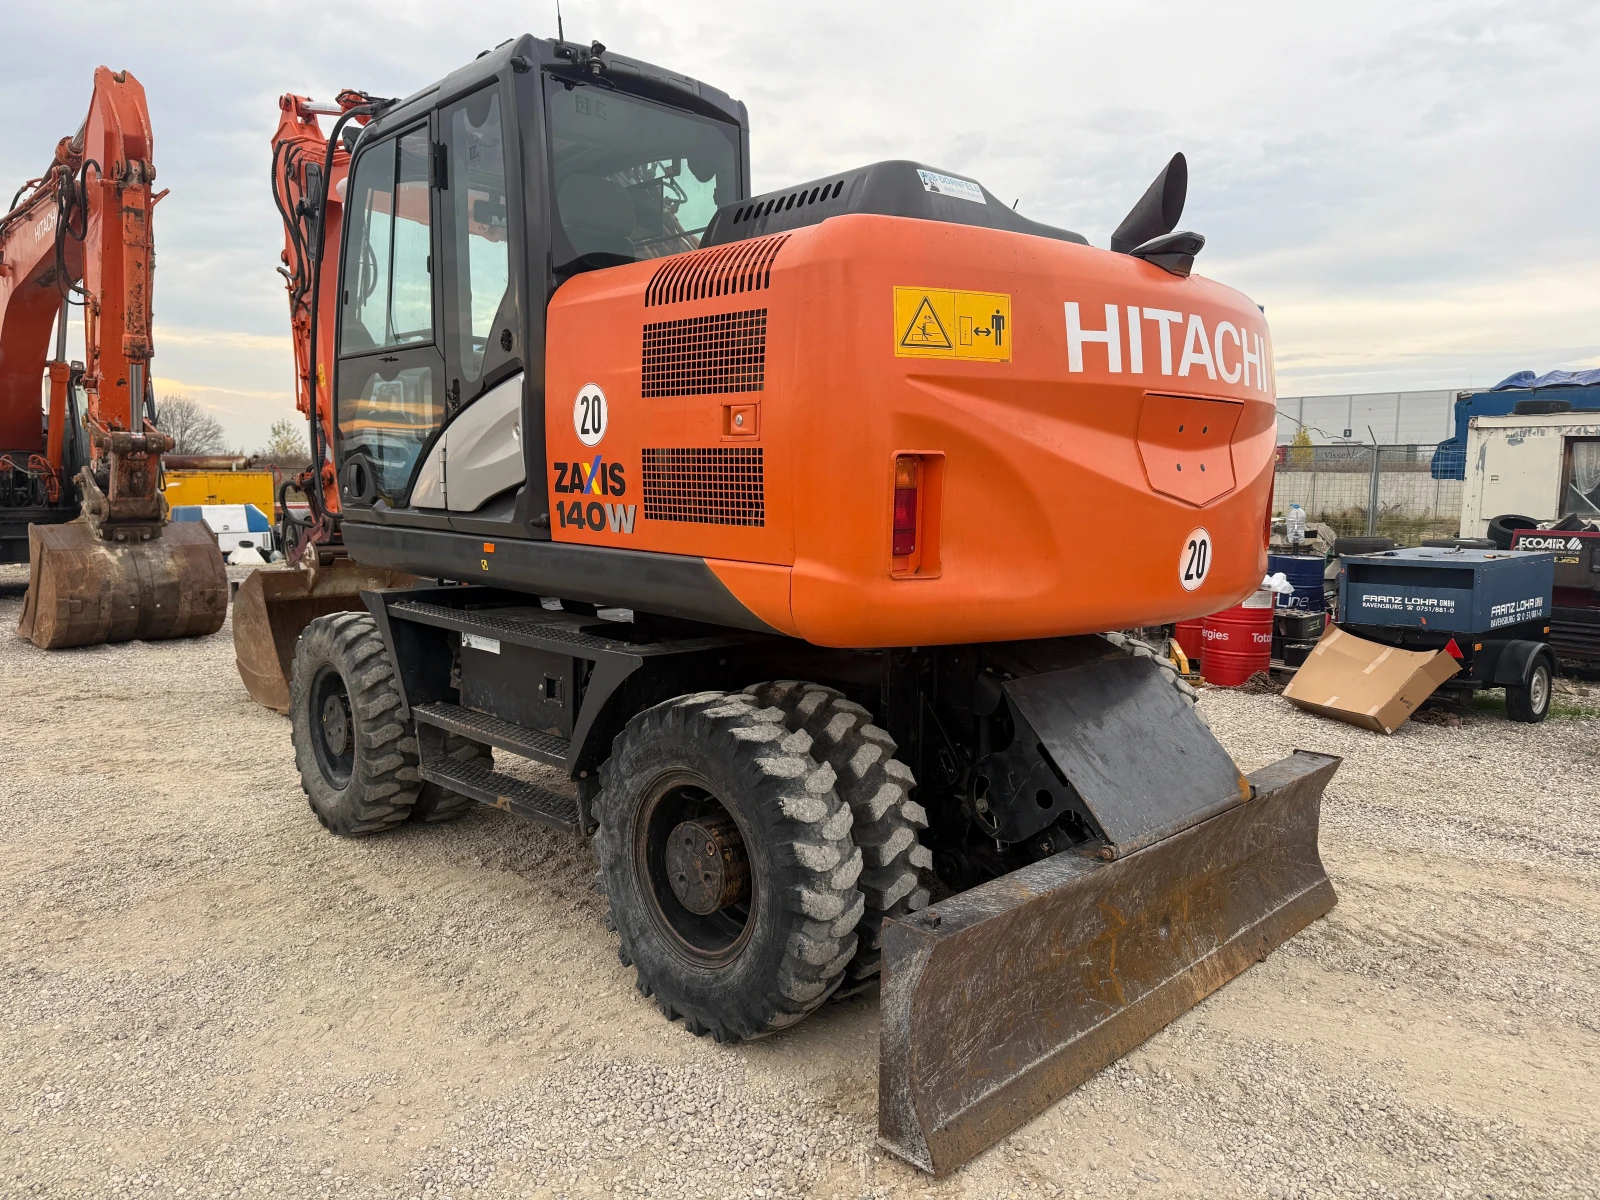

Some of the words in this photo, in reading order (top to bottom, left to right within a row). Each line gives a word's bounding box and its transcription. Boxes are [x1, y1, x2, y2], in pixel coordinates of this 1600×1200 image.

[34, 206, 58, 244] HITACHI
[1063, 301, 1268, 394] HITACHI
[580, 394, 602, 435] 20
[553, 454, 626, 497] ZAXIS
[556, 500, 638, 535] 140W
[1183, 538, 1208, 581] 20
[1518, 537, 1566, 550] ECOAIR
[1362, 594, 1403, 604] FRANZ
[1404, 597, 1438, 606] LOHR
[1362, 602, 1403, 610] RAVENSBURG
[1416, 605, 1455, 614] 0751/881-0
[1490, 601, 1516, 617] FRANZ
[1516, 598, 1535, 612] LOHR
